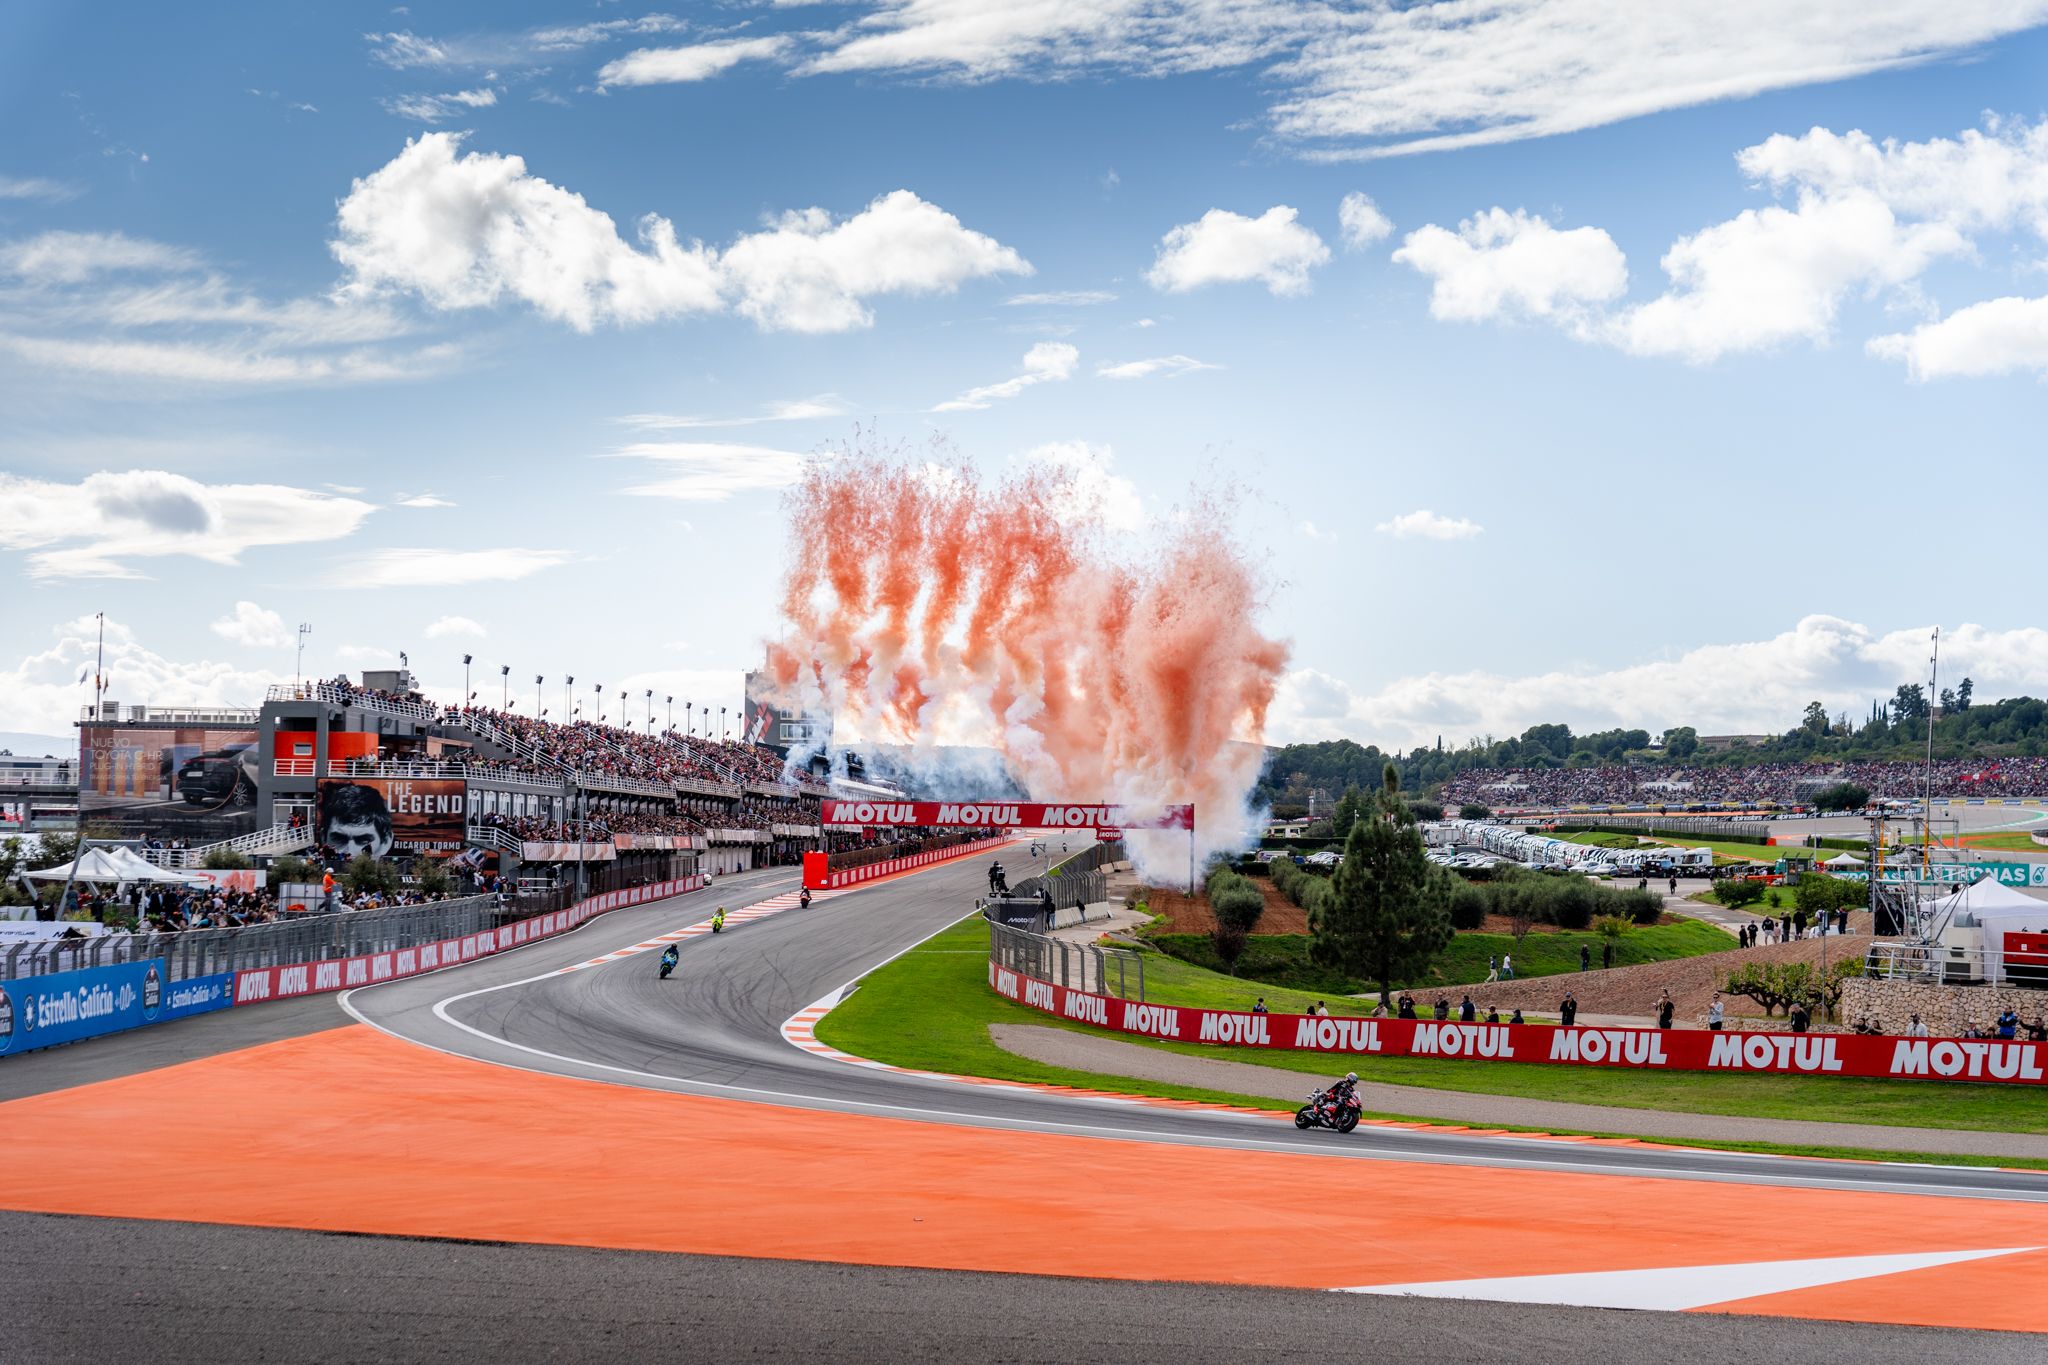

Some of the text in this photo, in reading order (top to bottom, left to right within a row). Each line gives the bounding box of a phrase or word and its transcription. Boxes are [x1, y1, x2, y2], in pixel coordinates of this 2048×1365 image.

[90, 737, 130, 748] NUEVO
[90, 749, 163, 760] TOYOTA C-HR
[386, 781, 412, 795] THE
[387, 794, 463, 814] LEGEND
[832, 803, 917, 823] MOTUL
[936, 804, 1022, 824] MOTUL
[1776, 812, 1808, 820] alpinestars
[1821, 810, 1852, 818] alpinestars
[1731, 814, 1763, 822] alpinestars
[394, 840, 461, 850] RICARDO TORMO
[397, 949, 416, 976] MOTUL
[420, 944, 438, 969] MOTUL
[442, 940, 460, 964] MOTUL
[315, 961, 340, 990] MOTUL
[346, 958, 368, 985] MOTUL
[372, 953, 392, 980] MOTUL
[237, 970, 270, 1002] MOTUL
[278, 966, 308, 995] MOTUL
[997, 968, 1018, 999] MOTUL
[38, 993, 77, 1028] Estrella
[78, 983, 113, 1020] Galicia
[172, 989, 191, 1009] Estrella
[192, 985, 209, 1005] Galicia
[1025, 978, 1054, 1011] MOTUL
[1064, 991, 1108, 1025] MOTUL
[1123, 1002, 1180, 1037] MOTUL
[1199, 1012, 1271, 1045] MOTUL
[1295, 1018, 1382, 1051] MOTUL
[1411, 1023, 1515, 1058] MOTUL
[1549, 1028, 1668, 1065] MOTUL
[1707, 1034, 1844, 1071] MOTUL
[1890, 1040, 2044, 1080] MOTUL
